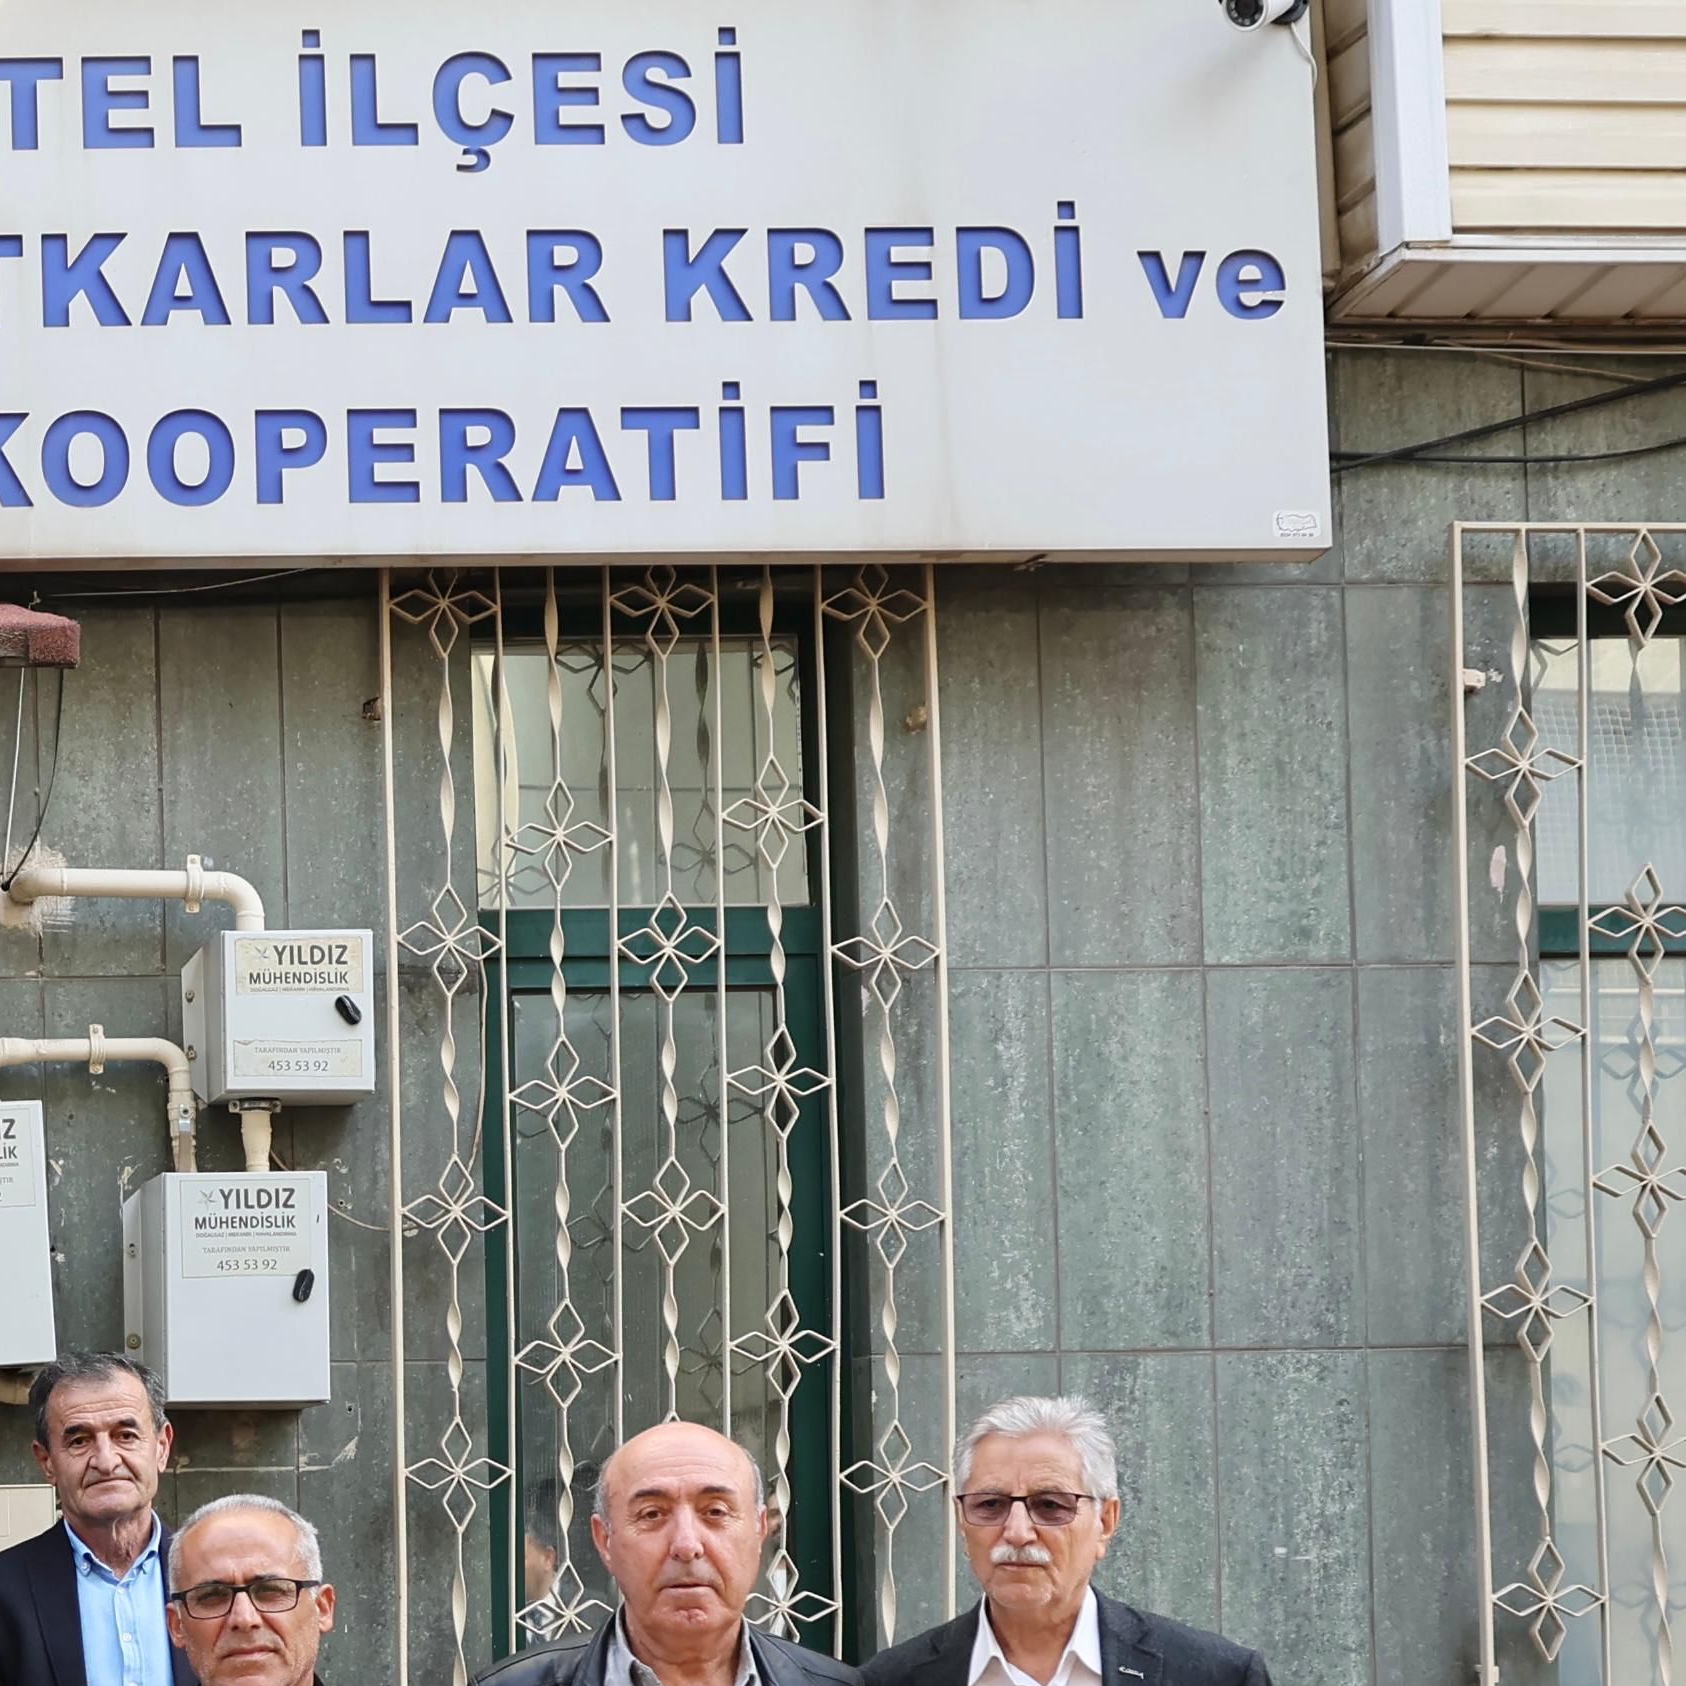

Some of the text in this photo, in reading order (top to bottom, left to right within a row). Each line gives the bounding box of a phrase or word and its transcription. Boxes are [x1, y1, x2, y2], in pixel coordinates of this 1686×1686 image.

[299, 26, 746, 172] İLÇESİ
[663, 200, 1084, 322] KREDİ
[1137, 250, 1286, 322] ve
[273, 944, 348, 965] YILDIZ
[249, 968, 348, 984] MÜHENDİSLİK
[268, 1060, 328, 1072] 453 53 92
[219, 1188, 296, 1209] YILDIZ
[195, 1212, 296, 1230] MÜHENDİSLİK
[217, 1259, 277, 1271] 453 53 92
